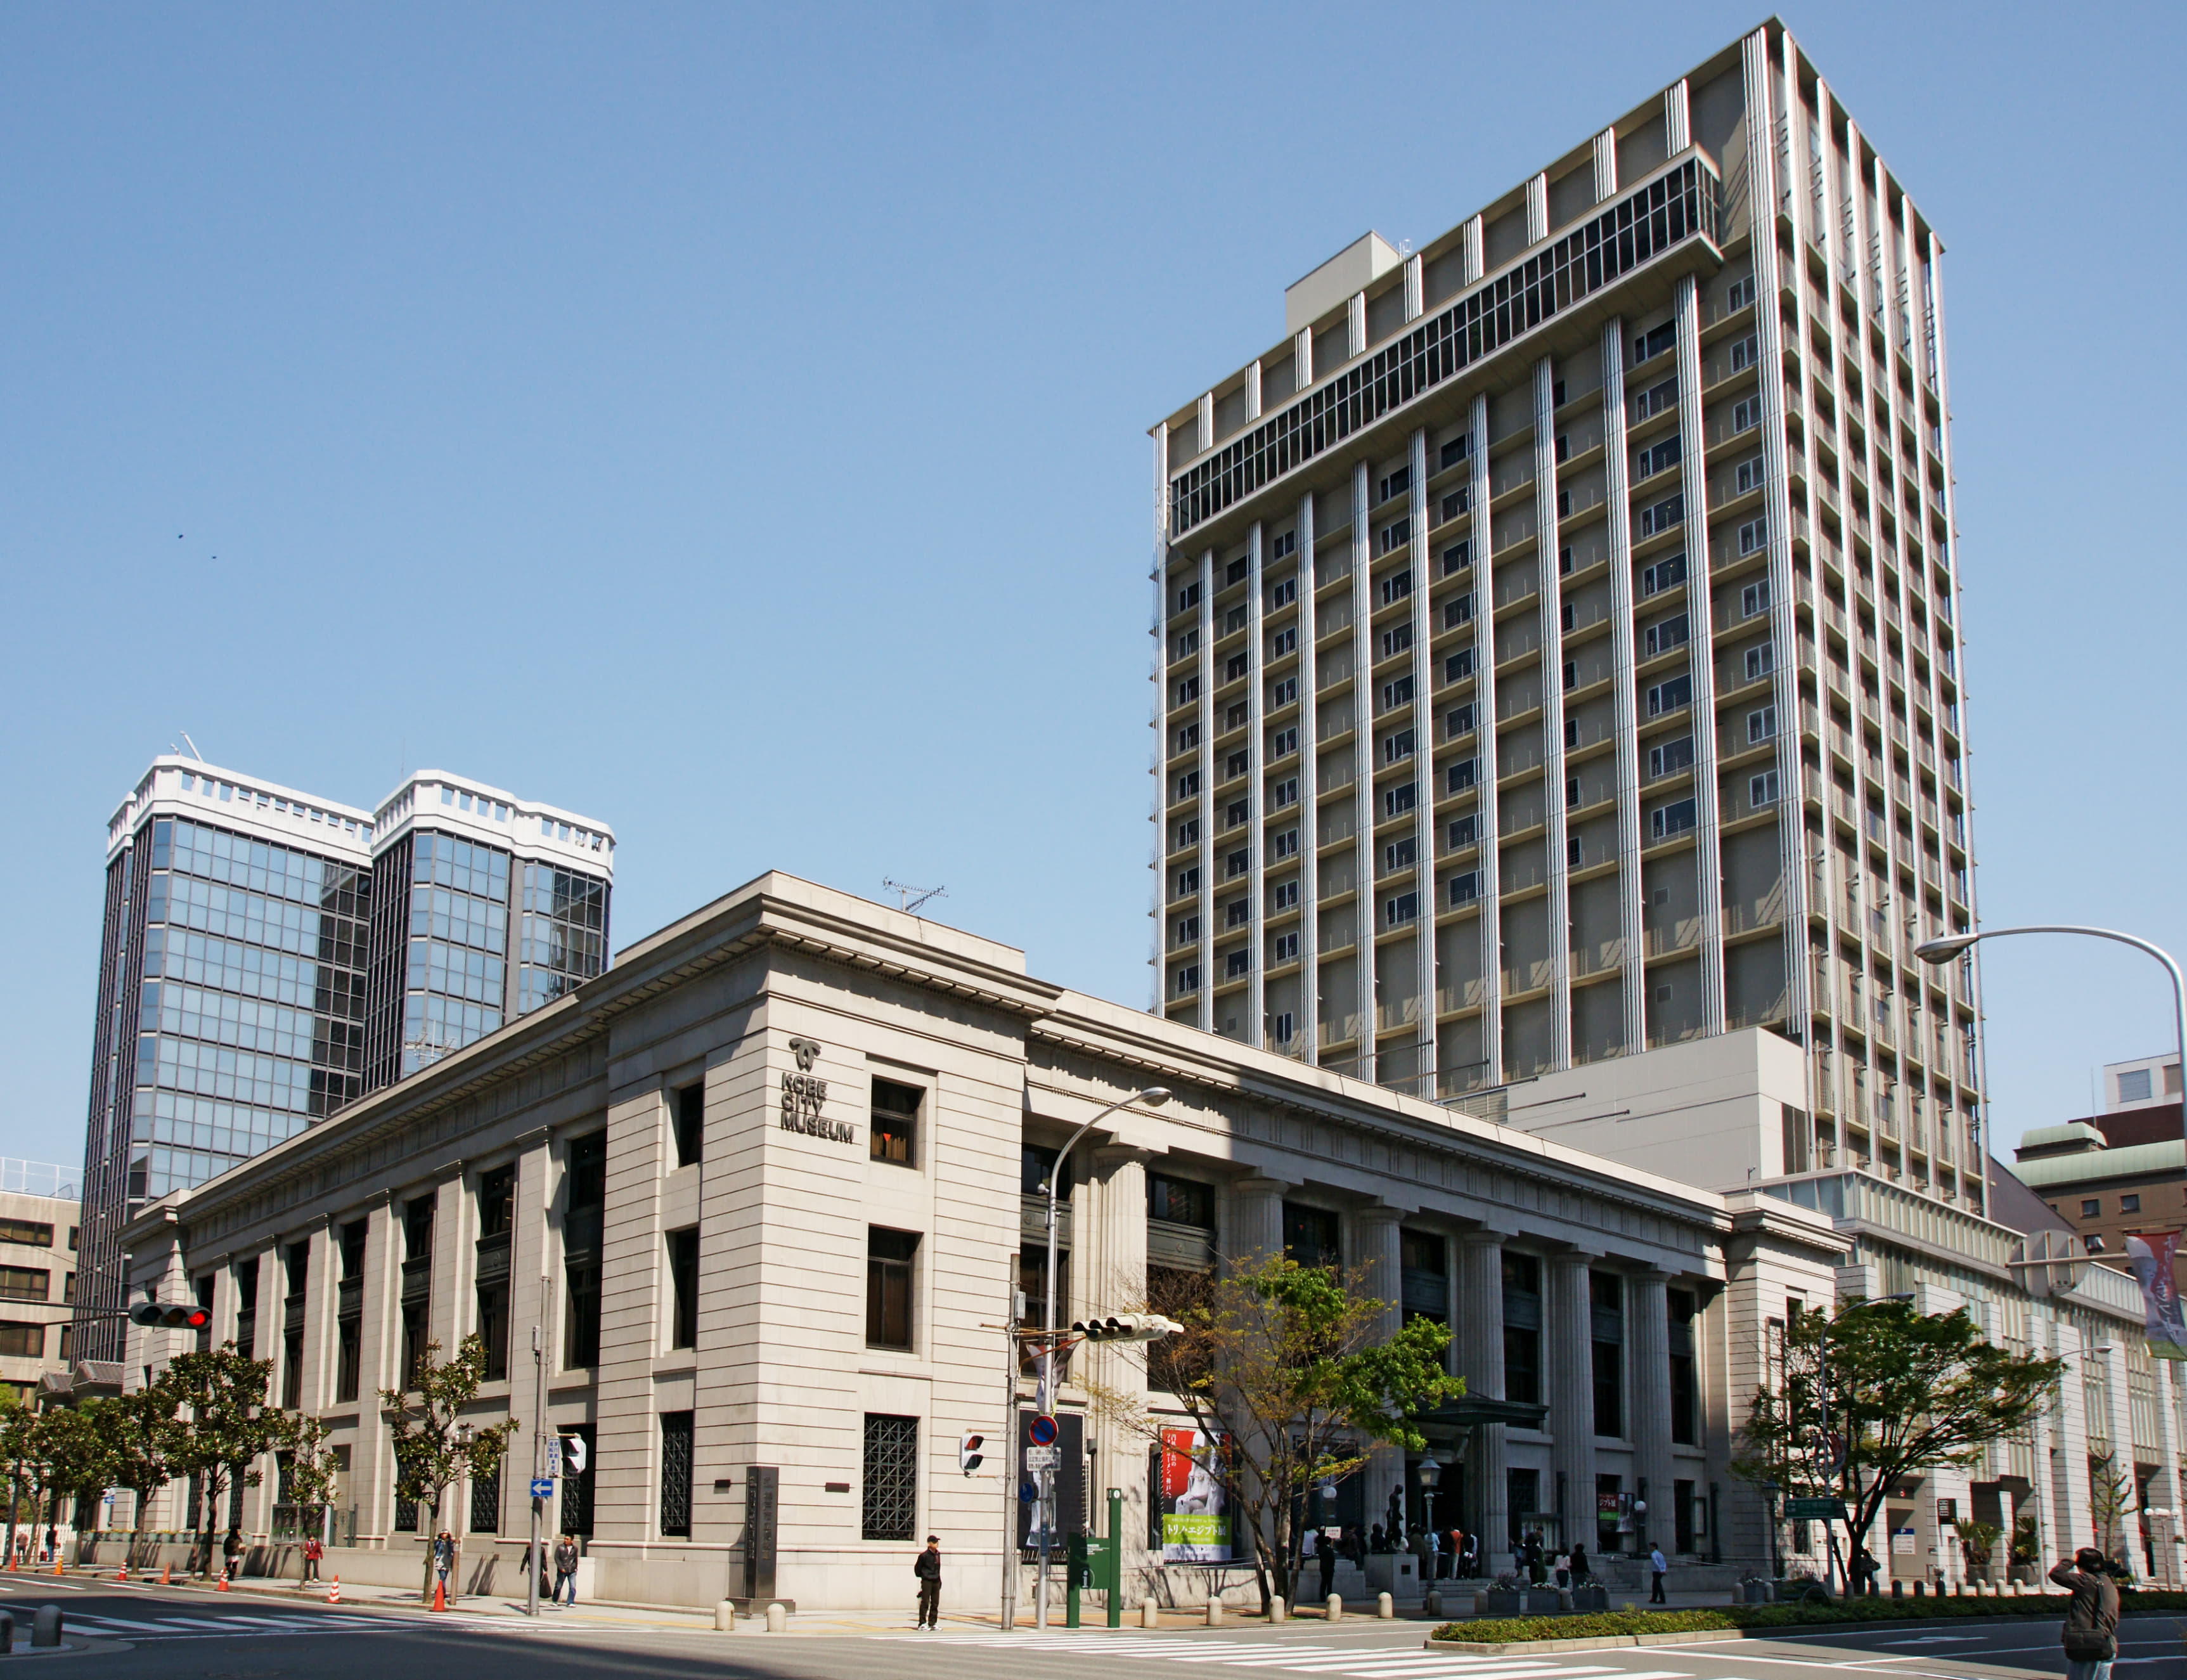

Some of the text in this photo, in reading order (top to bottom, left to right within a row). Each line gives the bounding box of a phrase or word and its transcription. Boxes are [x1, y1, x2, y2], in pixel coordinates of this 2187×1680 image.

[781, 1071, 827, 1101] KOBE
[781, 1092, 823, 1118] CITY
[781, 1111, 854, 1144] MUSEUM
